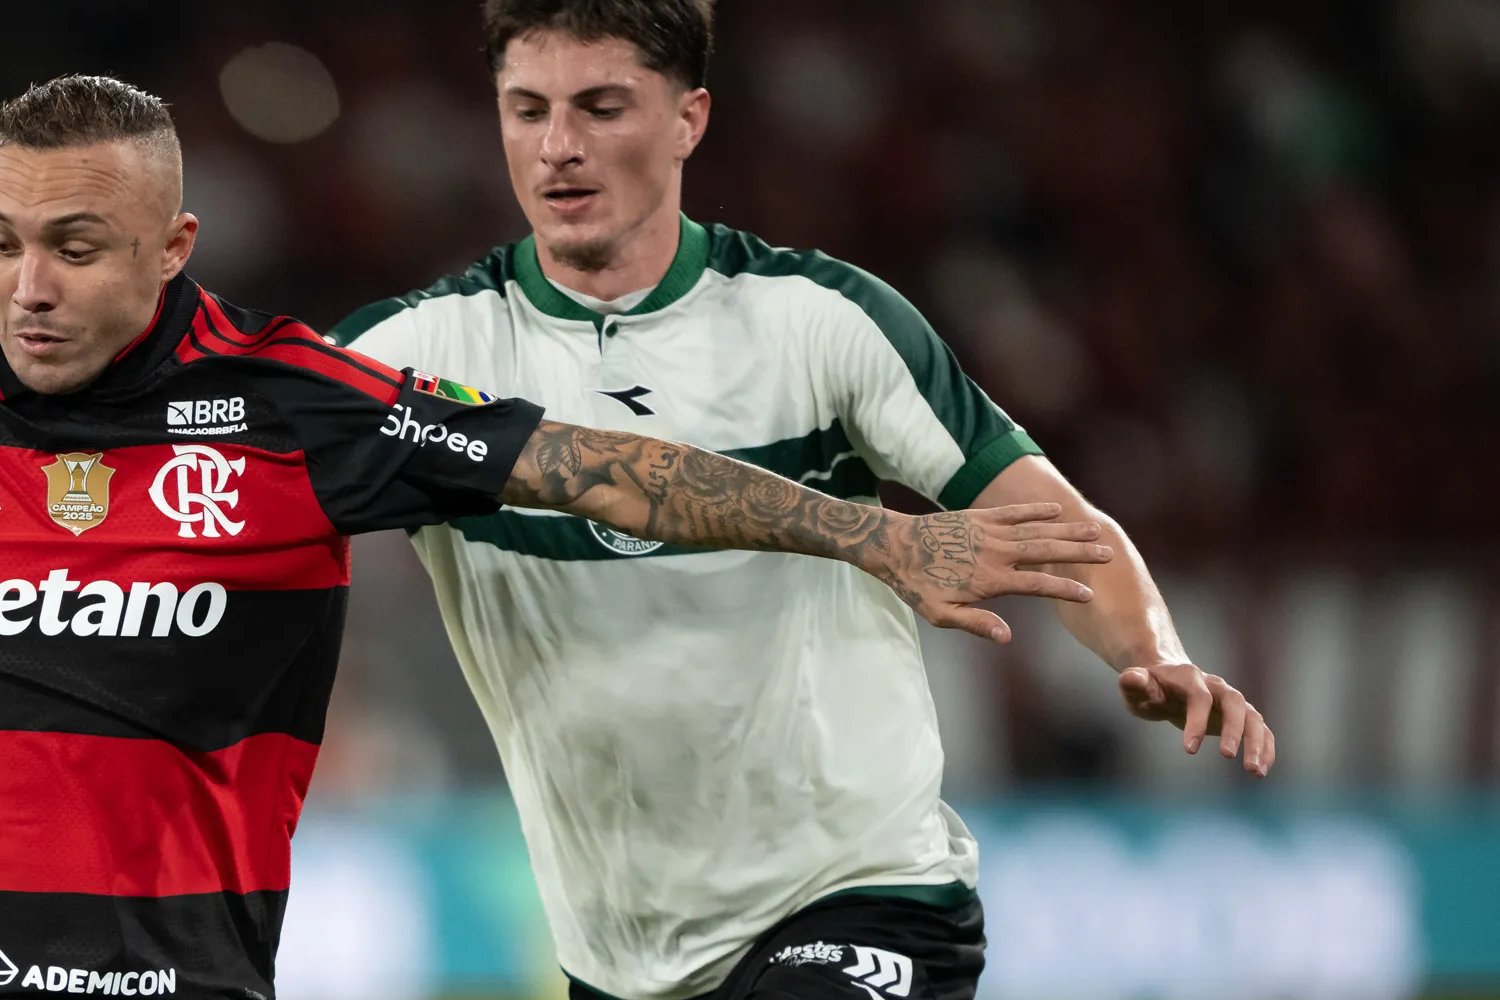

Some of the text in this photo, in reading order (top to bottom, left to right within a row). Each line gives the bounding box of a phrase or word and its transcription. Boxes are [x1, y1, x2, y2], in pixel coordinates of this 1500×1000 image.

[194, 396, 245, 424] BRB
[51, 503, 104, 513] CAMPEÃO
[62, 512, 93, 520] 2025
[21, 965, 176, 996] ADEMICON
